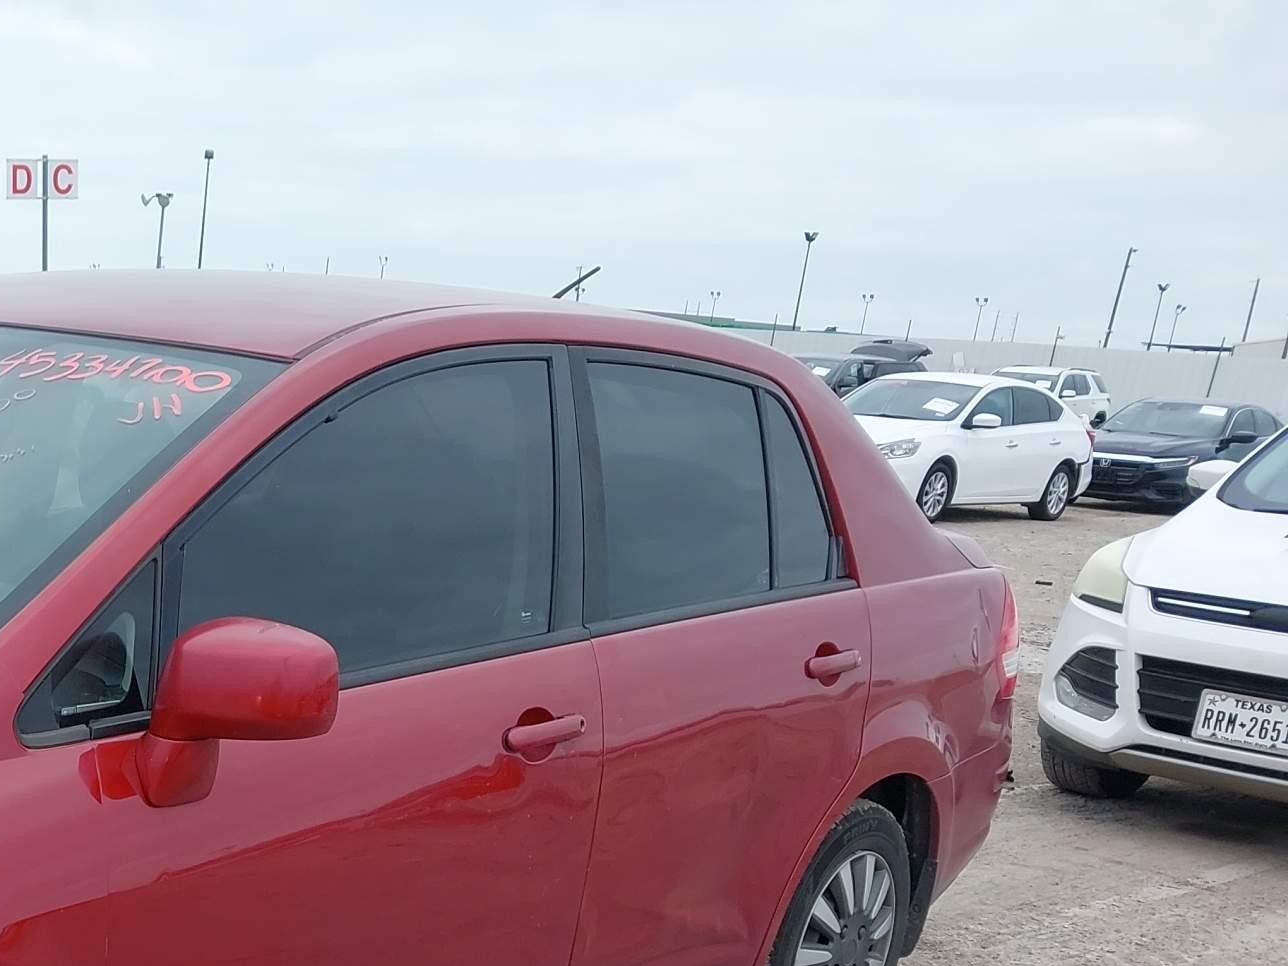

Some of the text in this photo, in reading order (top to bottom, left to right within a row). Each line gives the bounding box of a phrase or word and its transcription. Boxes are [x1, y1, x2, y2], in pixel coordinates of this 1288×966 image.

[12, 164, 73, 195] D C
[0, 349, 232, 392] 45334700
[1234, 699, 1273, 714] TEXAS
